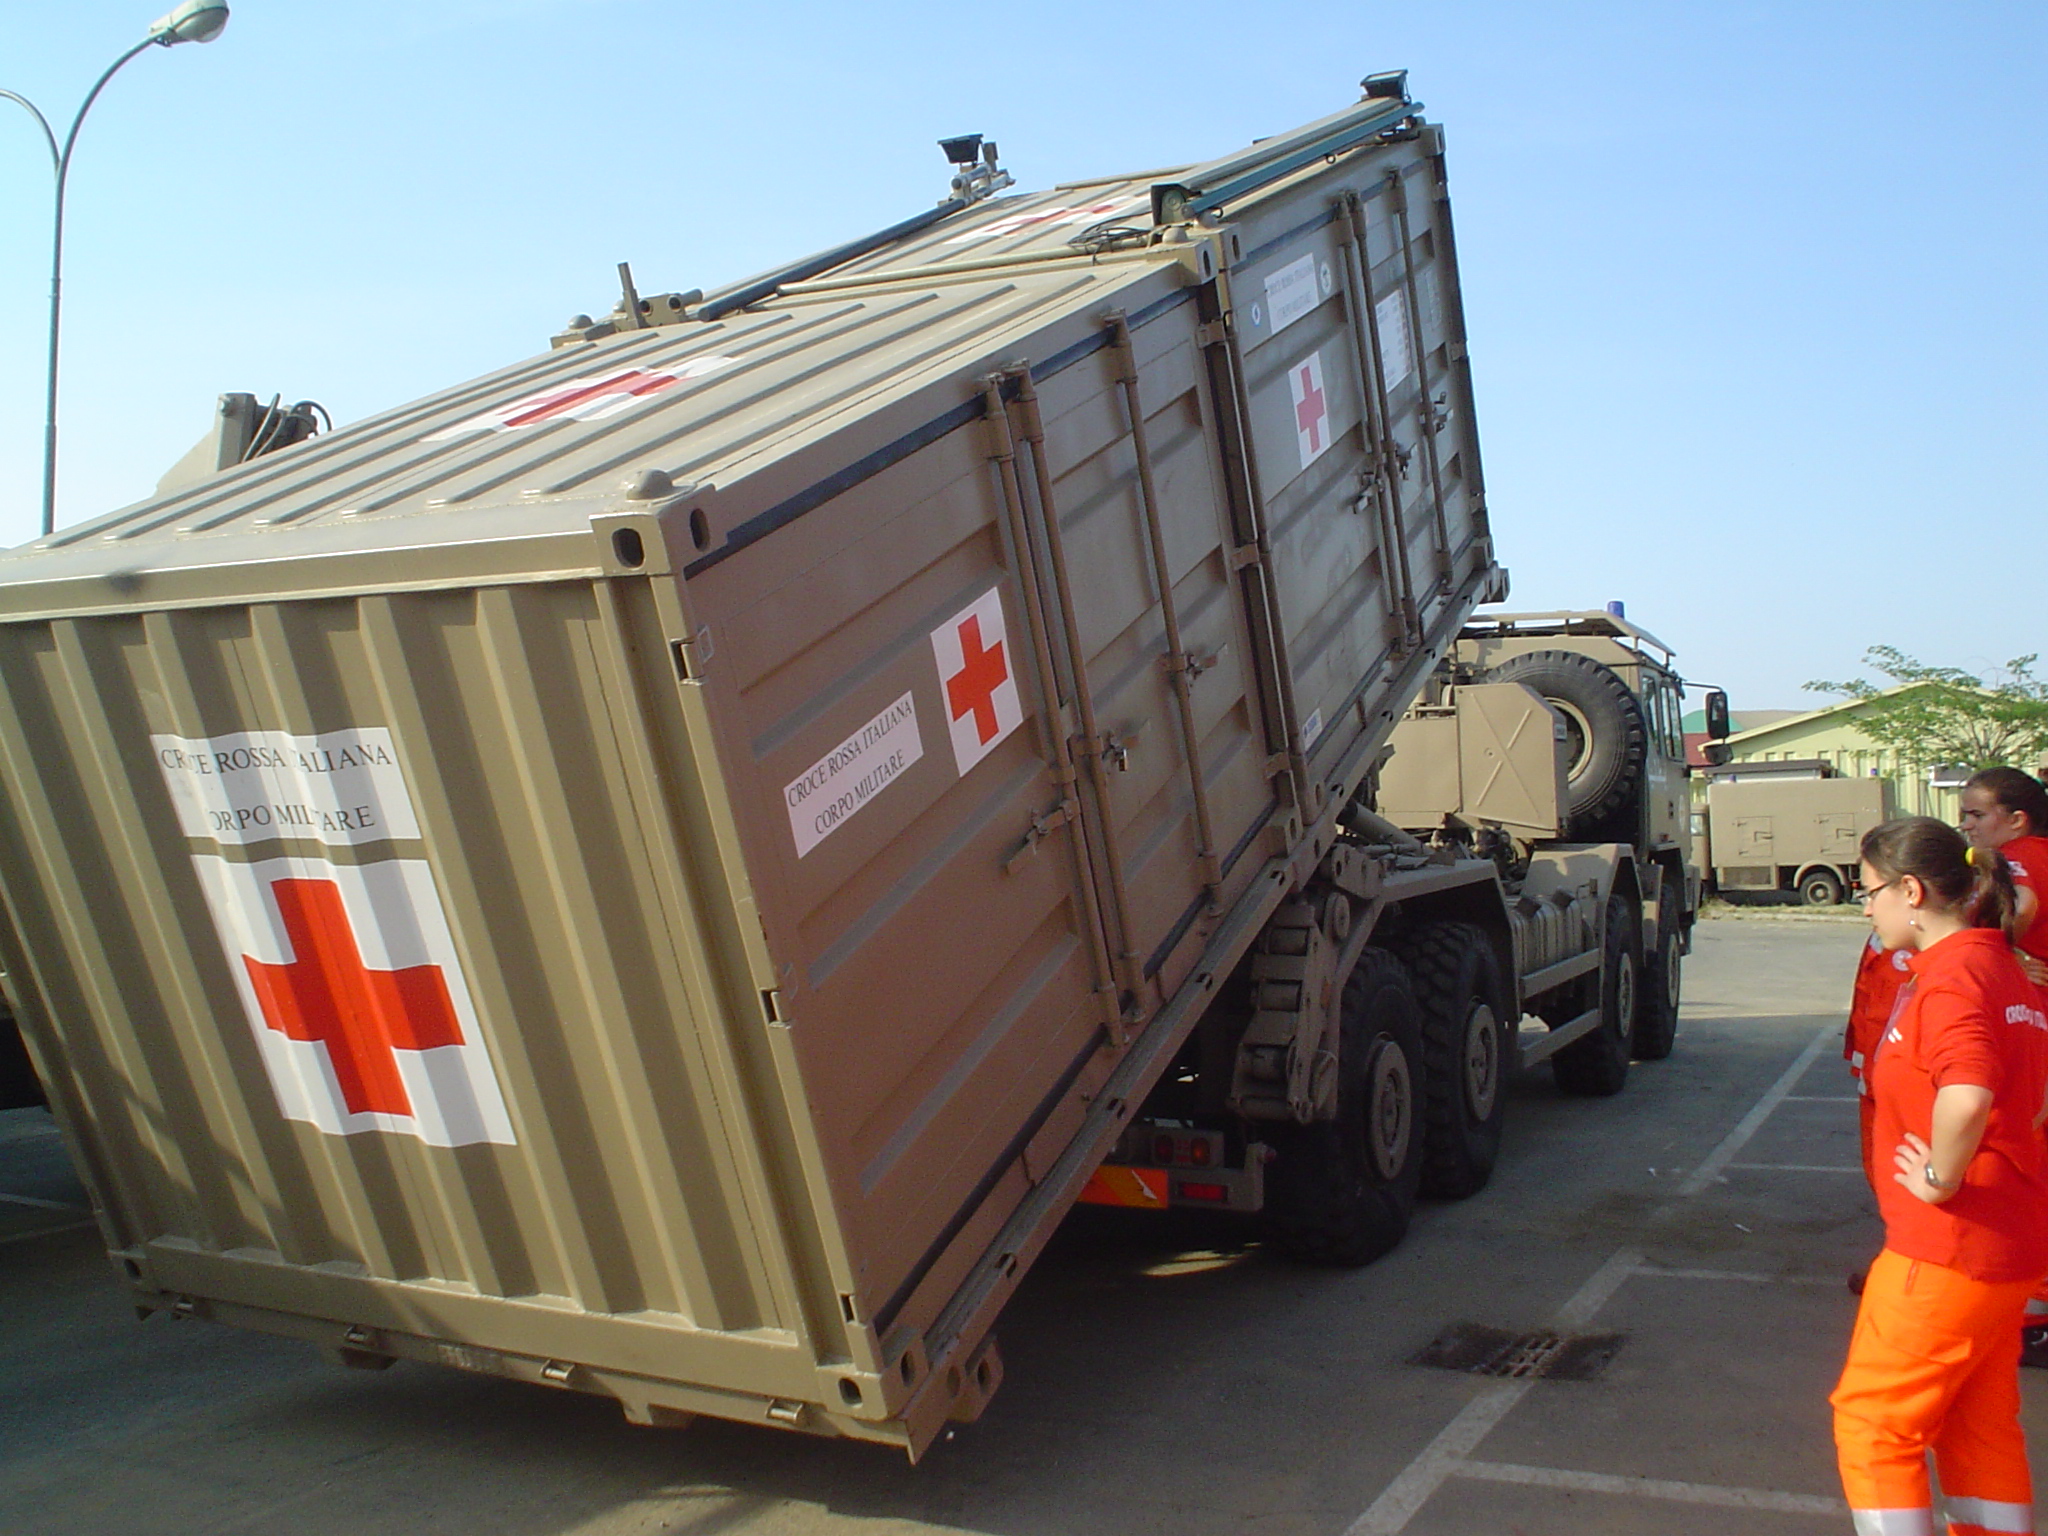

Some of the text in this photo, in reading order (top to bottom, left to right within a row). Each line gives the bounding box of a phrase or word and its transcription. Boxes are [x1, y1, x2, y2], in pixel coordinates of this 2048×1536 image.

[214, 747, 286, 774] ROSSA
[788, 700, 913, 807] CROCE ROSSA ITALIANA
[814, 749, 906, 834] CORPO MILITARE
